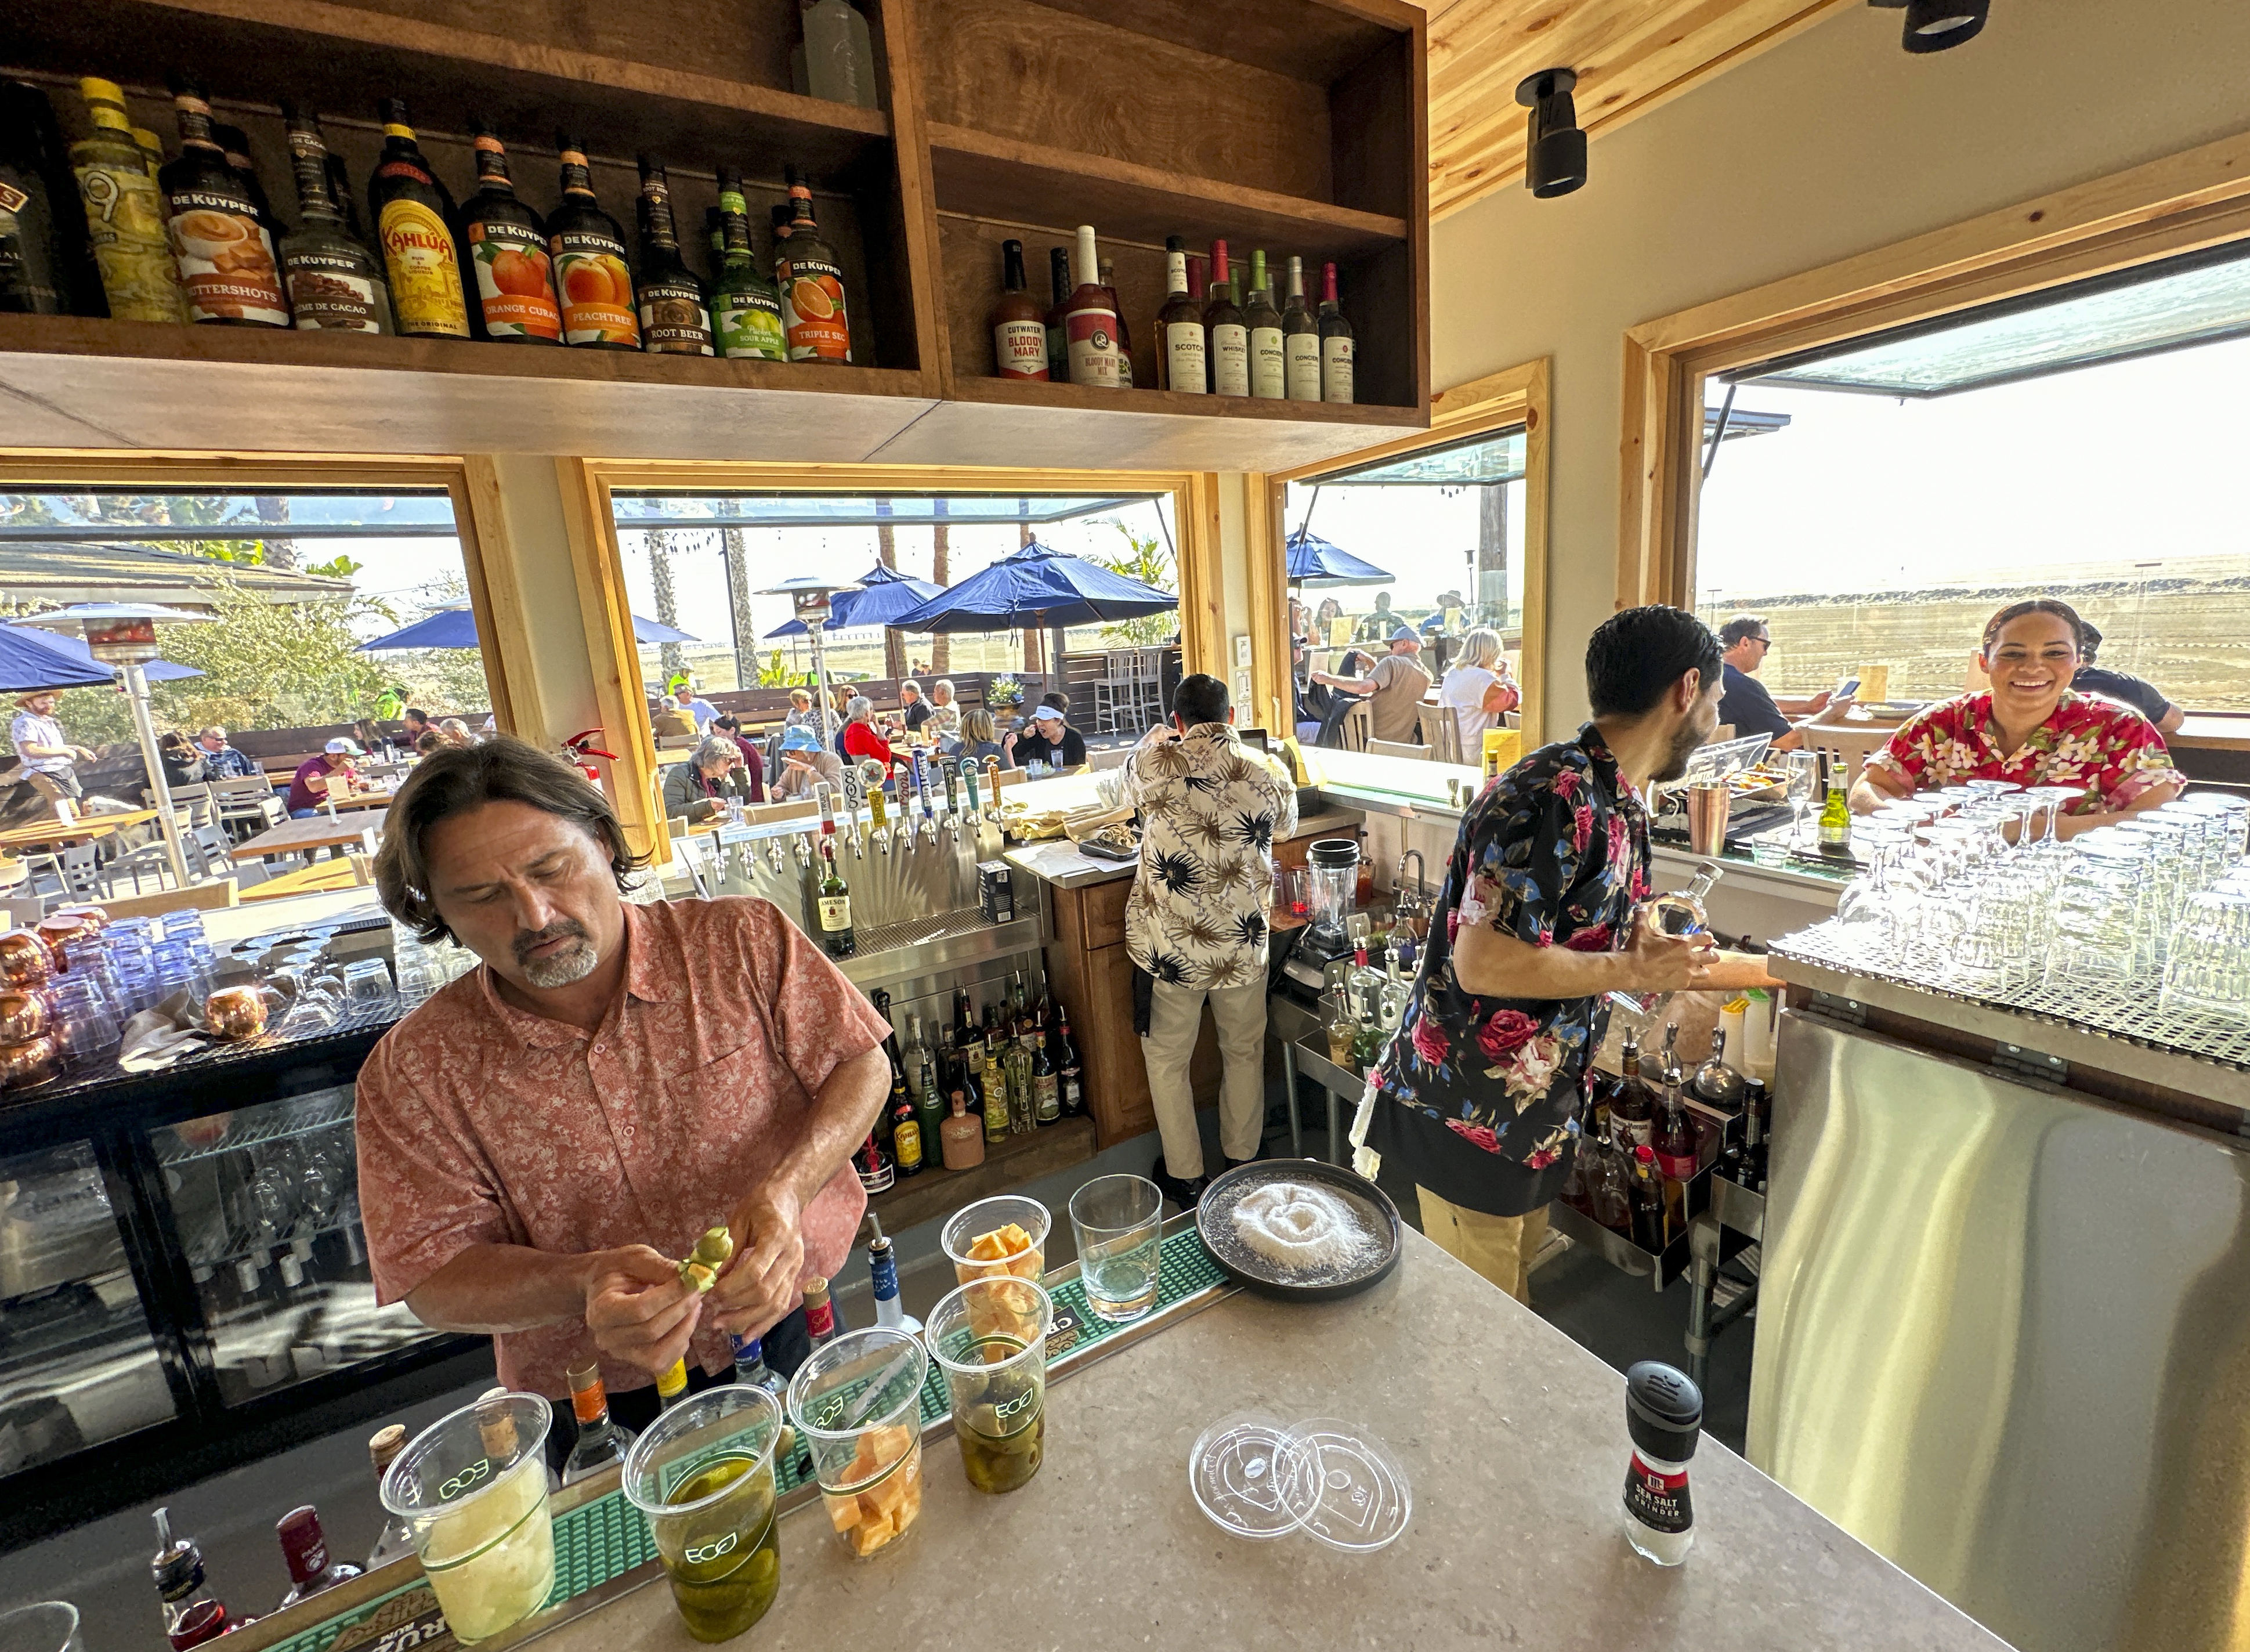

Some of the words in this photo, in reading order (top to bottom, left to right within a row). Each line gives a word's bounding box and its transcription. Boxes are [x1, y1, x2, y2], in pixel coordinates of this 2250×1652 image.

[191, 194, 259, 216] KUYPER
[487, 226, 505, 234] DE
[507, 225, 548, 247] KUYPER
[381, 225, 454, 264] KAHLÚA
[564, 236, 580, 244] DE
[581, 235, 625, 255] KUYPER
[300, 255, 355, 269] KUYPER
[793, 262, 806, 270] DE
[807, 261, 842, 277] KUYPER
[661, 288, 701, 302] KUYPER
[330, 303, 367, 315] CACAO
[747, 296, 779, 310] KUYPER
[486, 305, 526, 315] ORANGE
[421, 321, 458, 330] ORIGINAL
[573, 313, 632, 326] PEACHTREE
[652, 328, 677, 339] ROOT
[680, 329, 704, 341] BEER
[747, 324, 772, 337] Pucker
[799, 331, 830, 339] TRIPLE
[832, 332, 845, 342] SEC
[1008, 326, 1041, 334] CUTWATER
[761, 337, 779, 346] APPLE
[1008, 336, 1043, 347] BLOODY
[1175, 344, 1204, 352] SCOTCH
[1014, 348, 1040, 357] MARY
[1085, 357, 1104, 367] BLOODY
[1104, 356, 1116, 367] MARY
[1097, 366, 1108, 376] MIX
[845, 771, 858, 808] 805
[995, 1387, 1033, 1418] ECO
[1636, 1483, 1652, 1502] SEA
[1654, 1496, 1678, 1507] SALT
[1634, 1494, 1680, 1517] GRINDER
[685, 1531, 737, 1564] ECO
[379, 1622, 415, 1645] RUM
